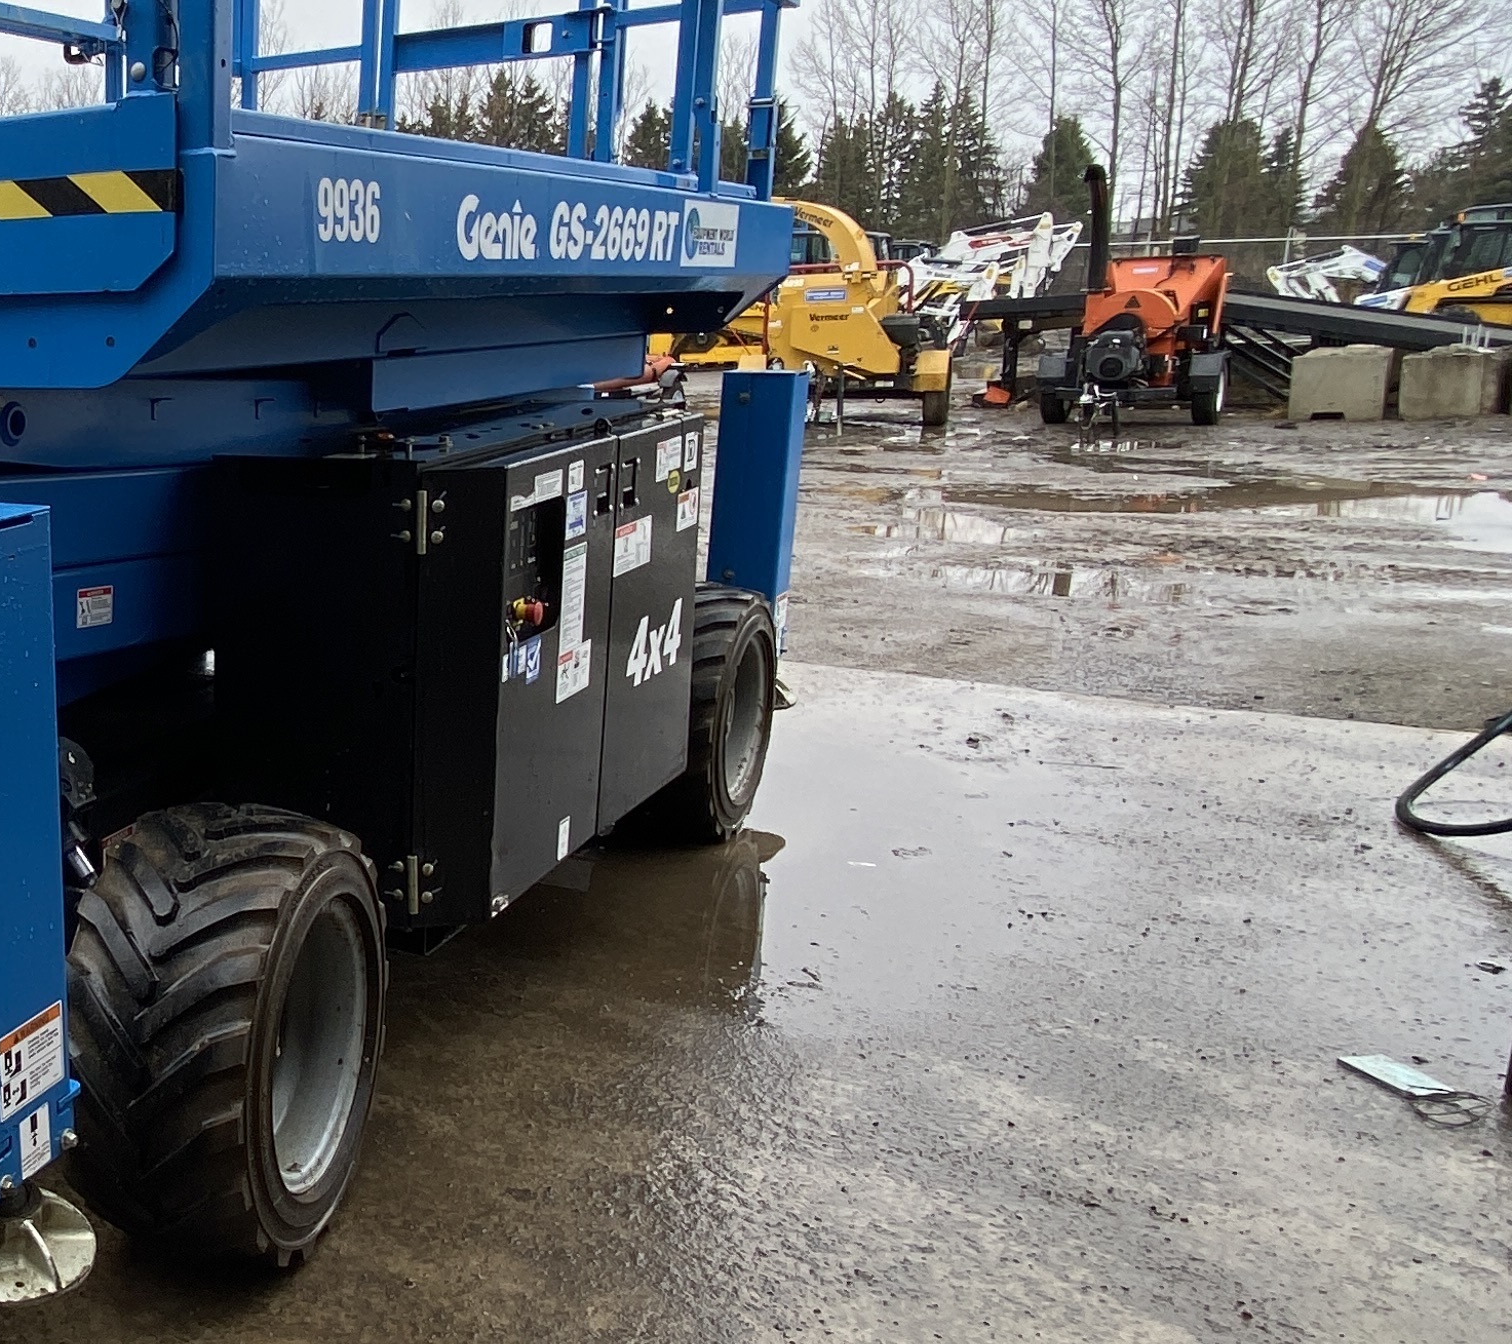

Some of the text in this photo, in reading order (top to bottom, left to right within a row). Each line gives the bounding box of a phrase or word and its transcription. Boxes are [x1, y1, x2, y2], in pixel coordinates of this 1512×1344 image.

[318, 177, 381, 243] 9936
[457, 194, 538, 261] Genie
[794, 206, 835, 229] Vermeer
[1448, 274, 1502, 291] GEHL
[809, 312, 850, 322] Vermeer
[625, 597, 684, 688] 4x4
